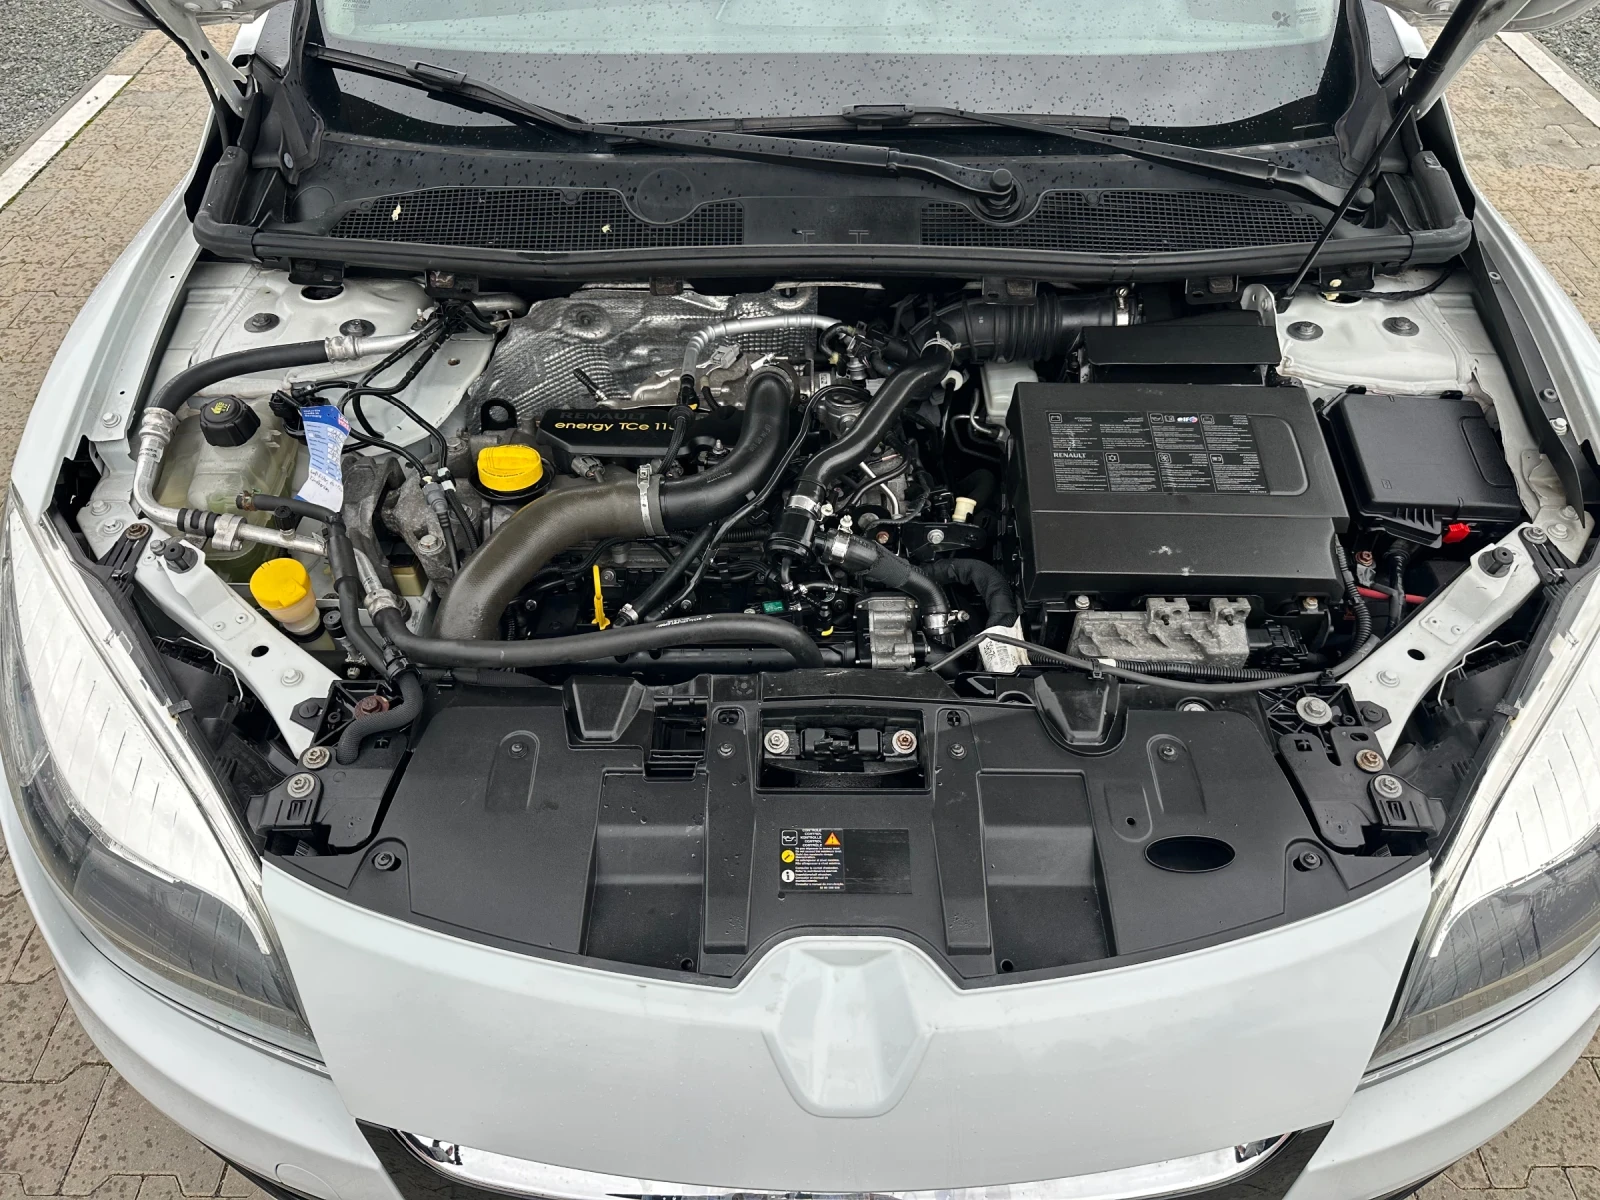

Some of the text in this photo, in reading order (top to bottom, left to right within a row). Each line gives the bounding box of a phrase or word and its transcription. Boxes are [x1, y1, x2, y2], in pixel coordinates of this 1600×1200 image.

[559, 412, 649, 420] RENAULT
[554, 422, 614, 432] energy
[619, 422, 650, 431] TCe
